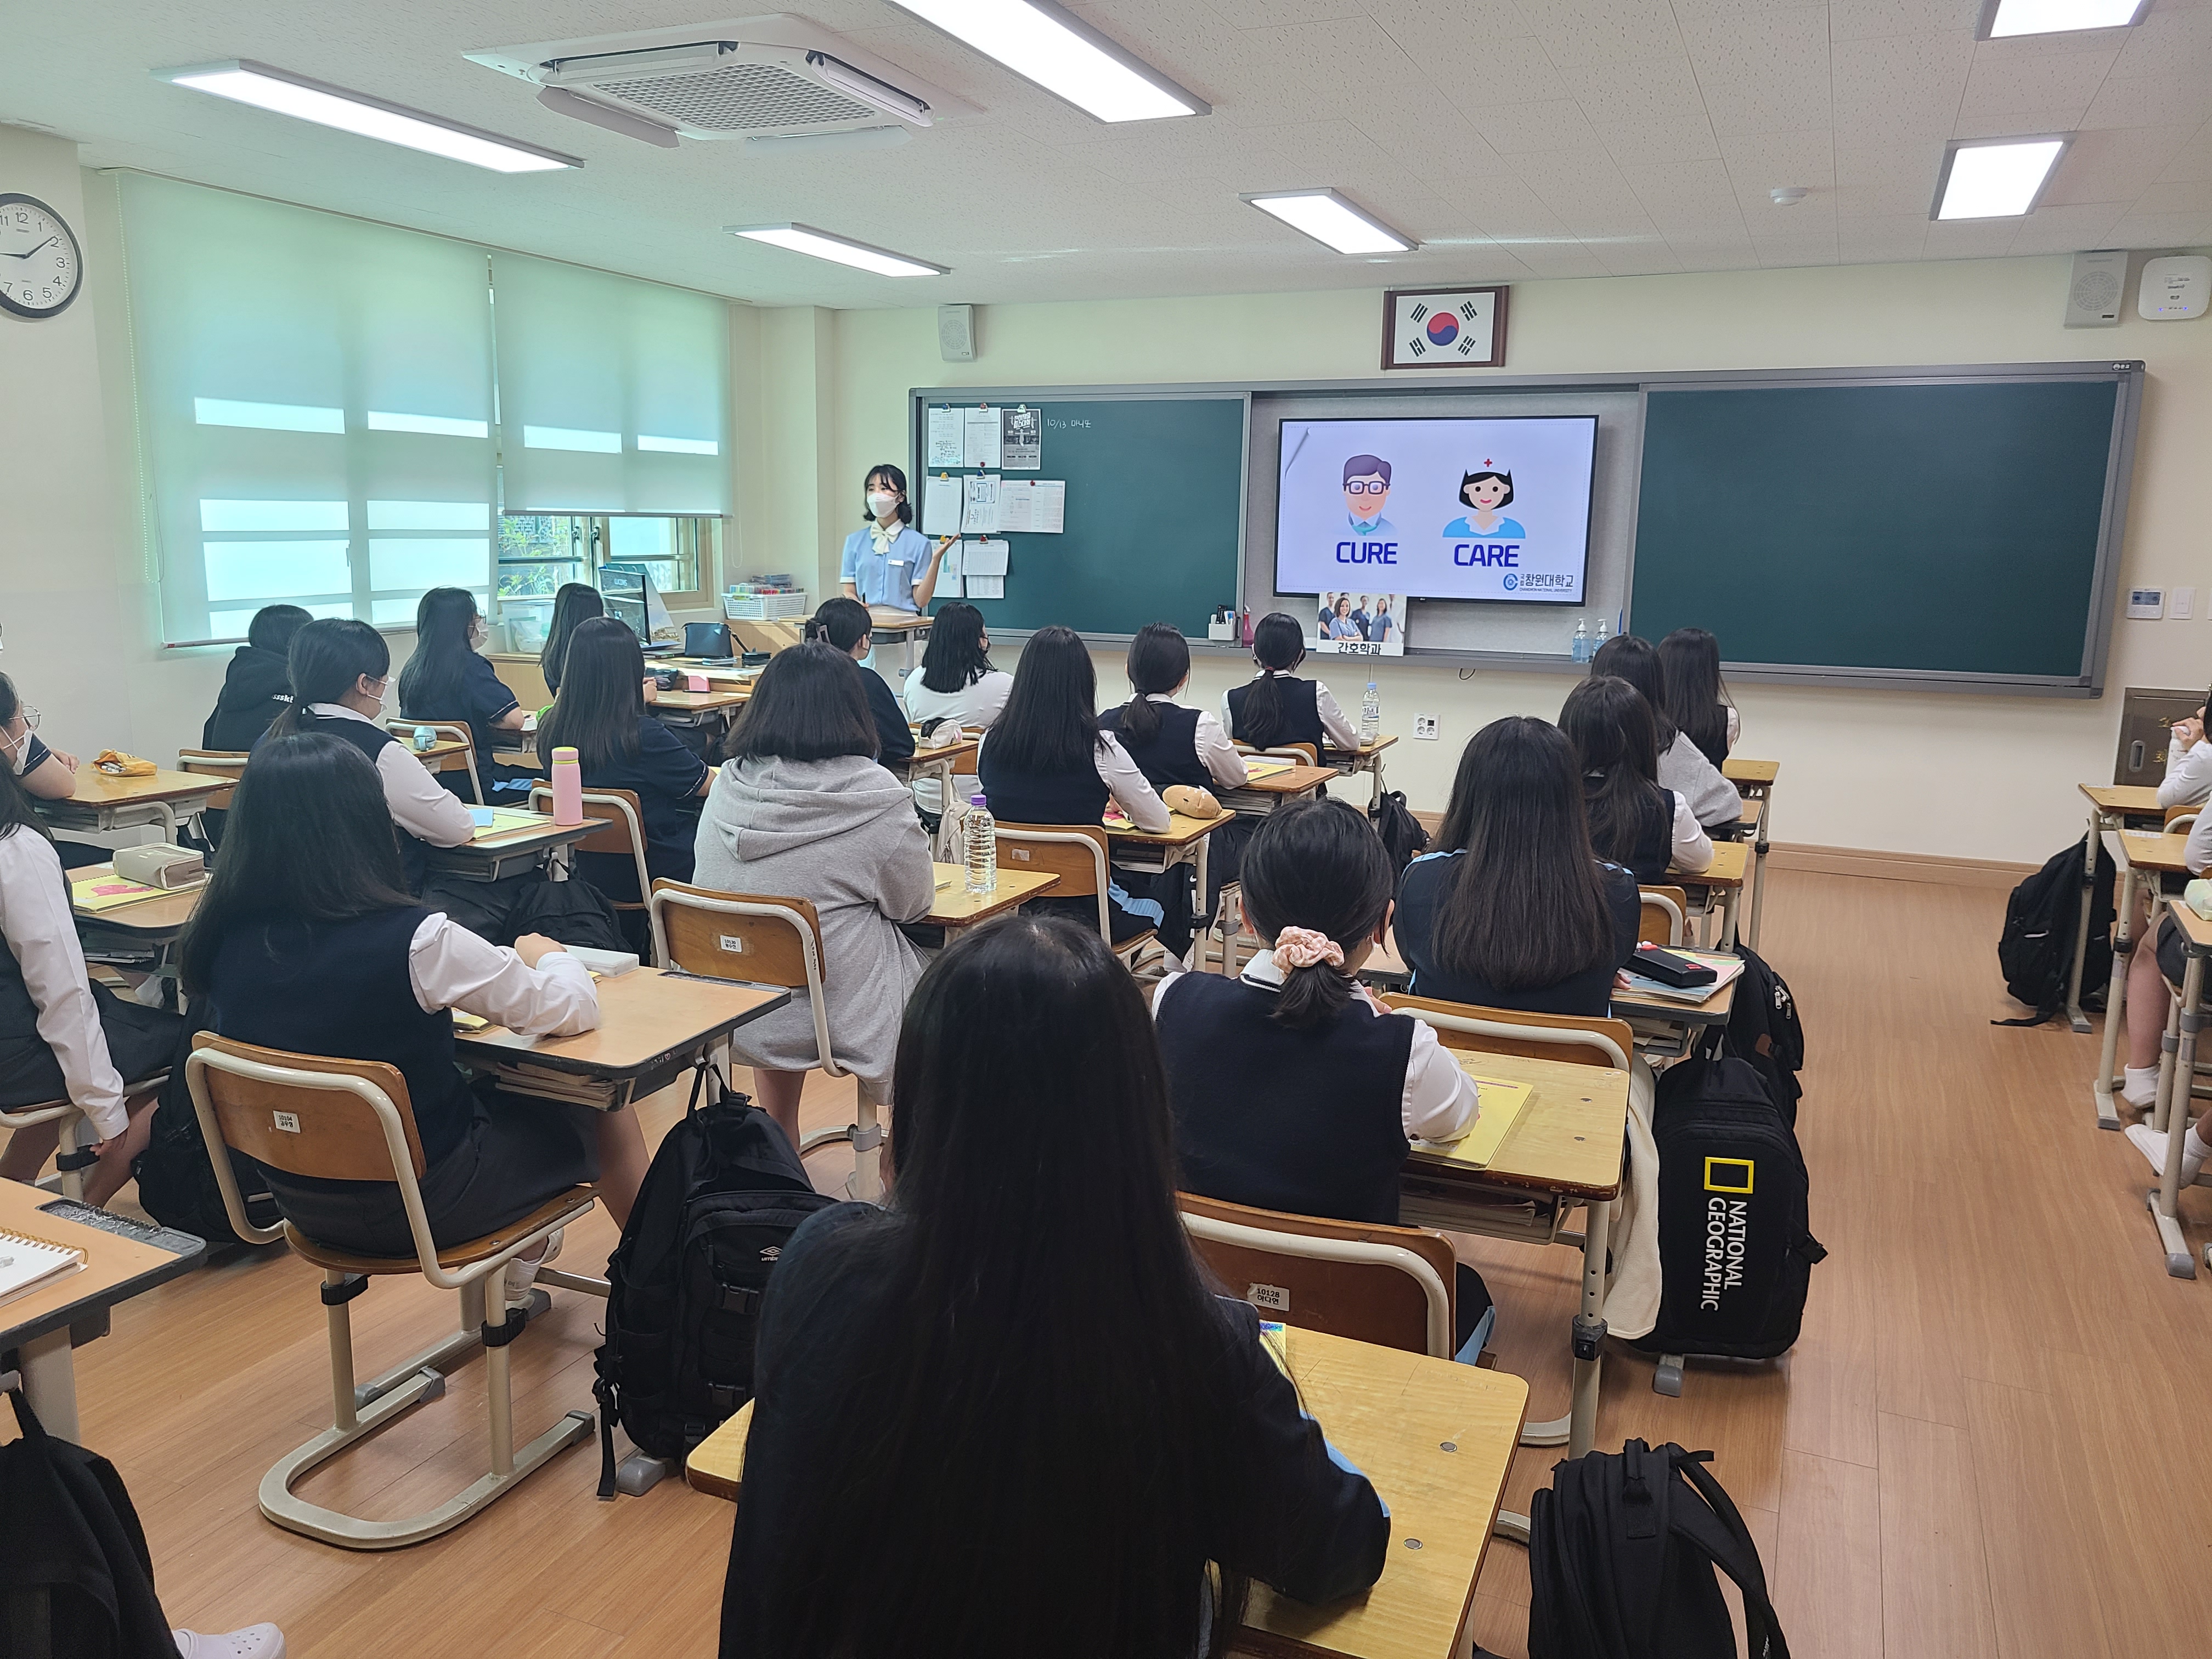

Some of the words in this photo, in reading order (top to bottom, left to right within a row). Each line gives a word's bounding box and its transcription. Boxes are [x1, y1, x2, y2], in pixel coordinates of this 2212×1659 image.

[15, 212, 29, 224] 12
[38, 222, 42, 232] 1
[50, 236, 59, 247] 2
[56, 257, 65, 268] 3
[3, 281, 13, 292] 7
[53, 276, 61, 286] 4
[23, 290, 33, 301] 6
[42, 287, 52, 298] 5
[1047, 419, 1066, 430] 10/13
[1336, 542, 1398, 565] CURE
[1454, 544, 1520, 567] CARE
[1526, 574, 1573, 587] 창원대학교
[1338, 642, 1381, 655] 간호학과
[1723, 1200, 1747, 1290] NATIONAL
[1700, 1197, 1726, 1311] GEOGRAPHIC
[1257, 1288, 1280, 1297] 10128
